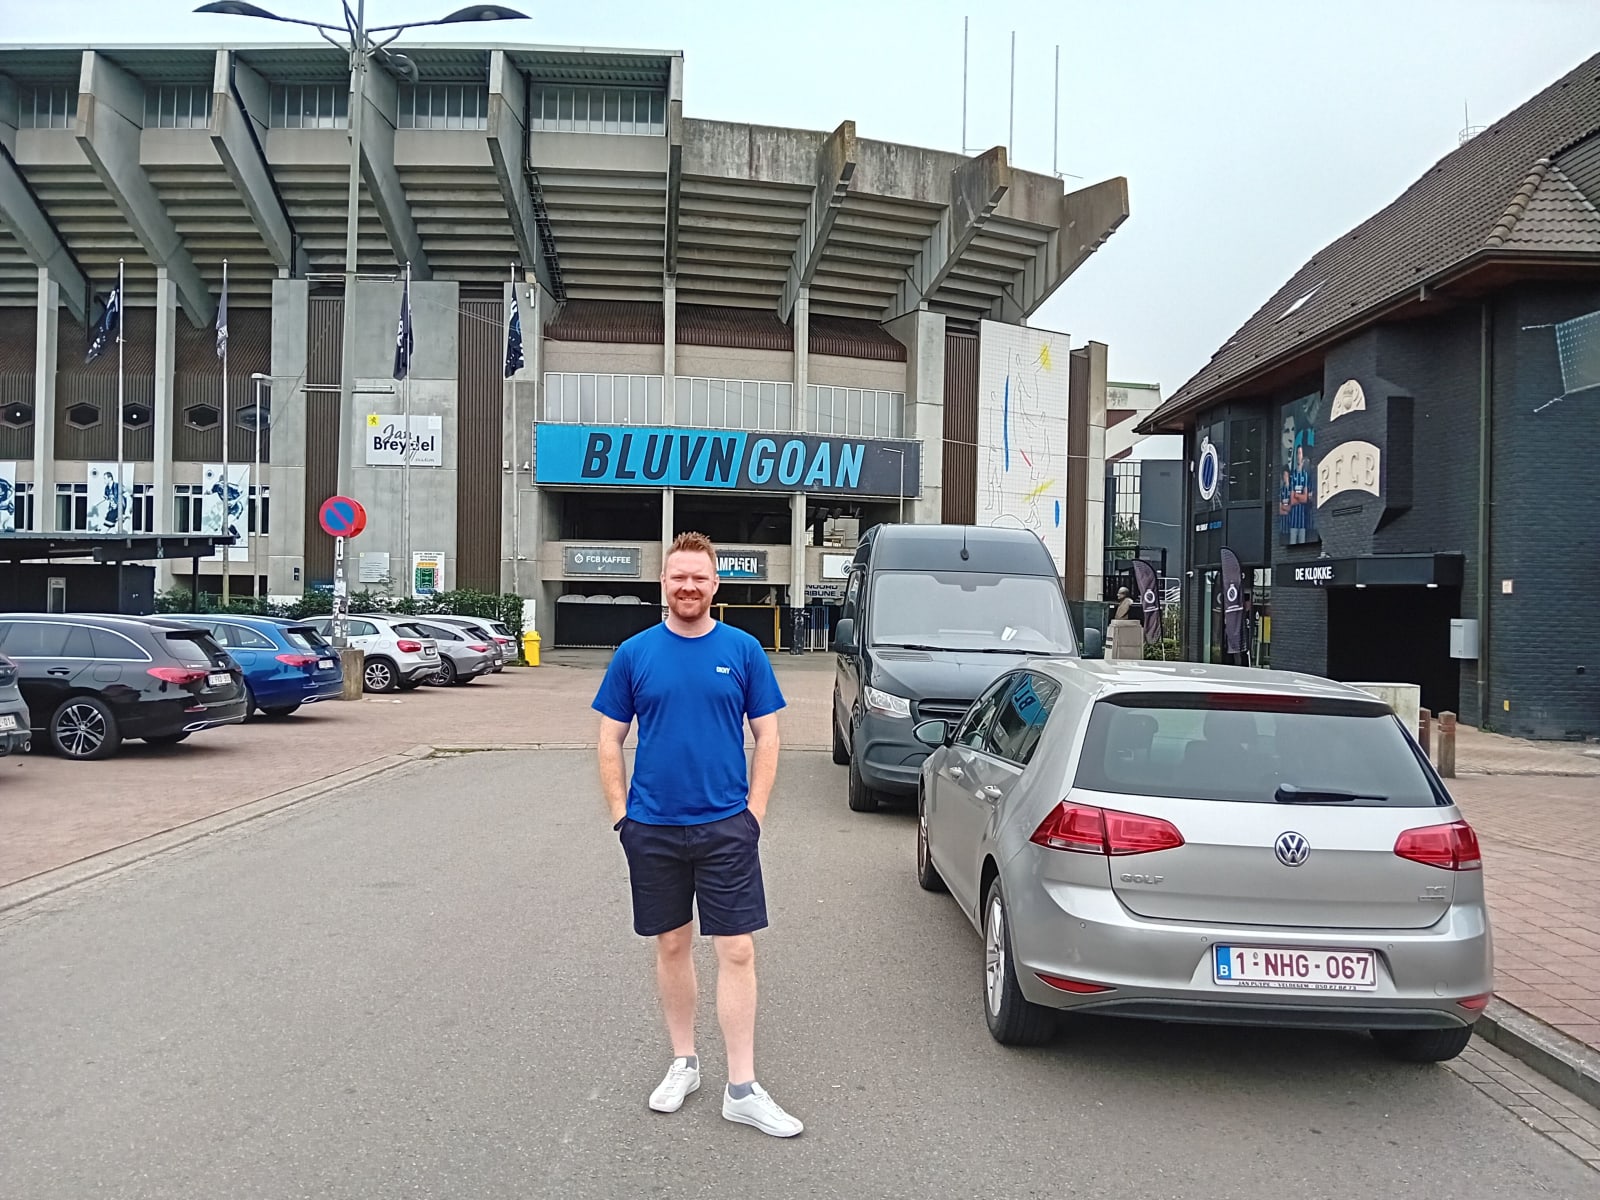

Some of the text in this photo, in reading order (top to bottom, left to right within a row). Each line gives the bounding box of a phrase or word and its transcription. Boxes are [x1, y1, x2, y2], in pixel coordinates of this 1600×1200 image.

[382, 423, 412, 443] Jan
[373, 435, 434, 455] Breydel
[580, 431, 865, 488] BLUVN GOAN
[1320, 452, 1376, 499] RFCB
[586, 555, 631, 564] FCB KAFFEE
[1295, 566, 1332, 581] DE KLOKKE
[1120, 873, 1164, 885] GOLF
[1219, 964, 1229, 976] B
